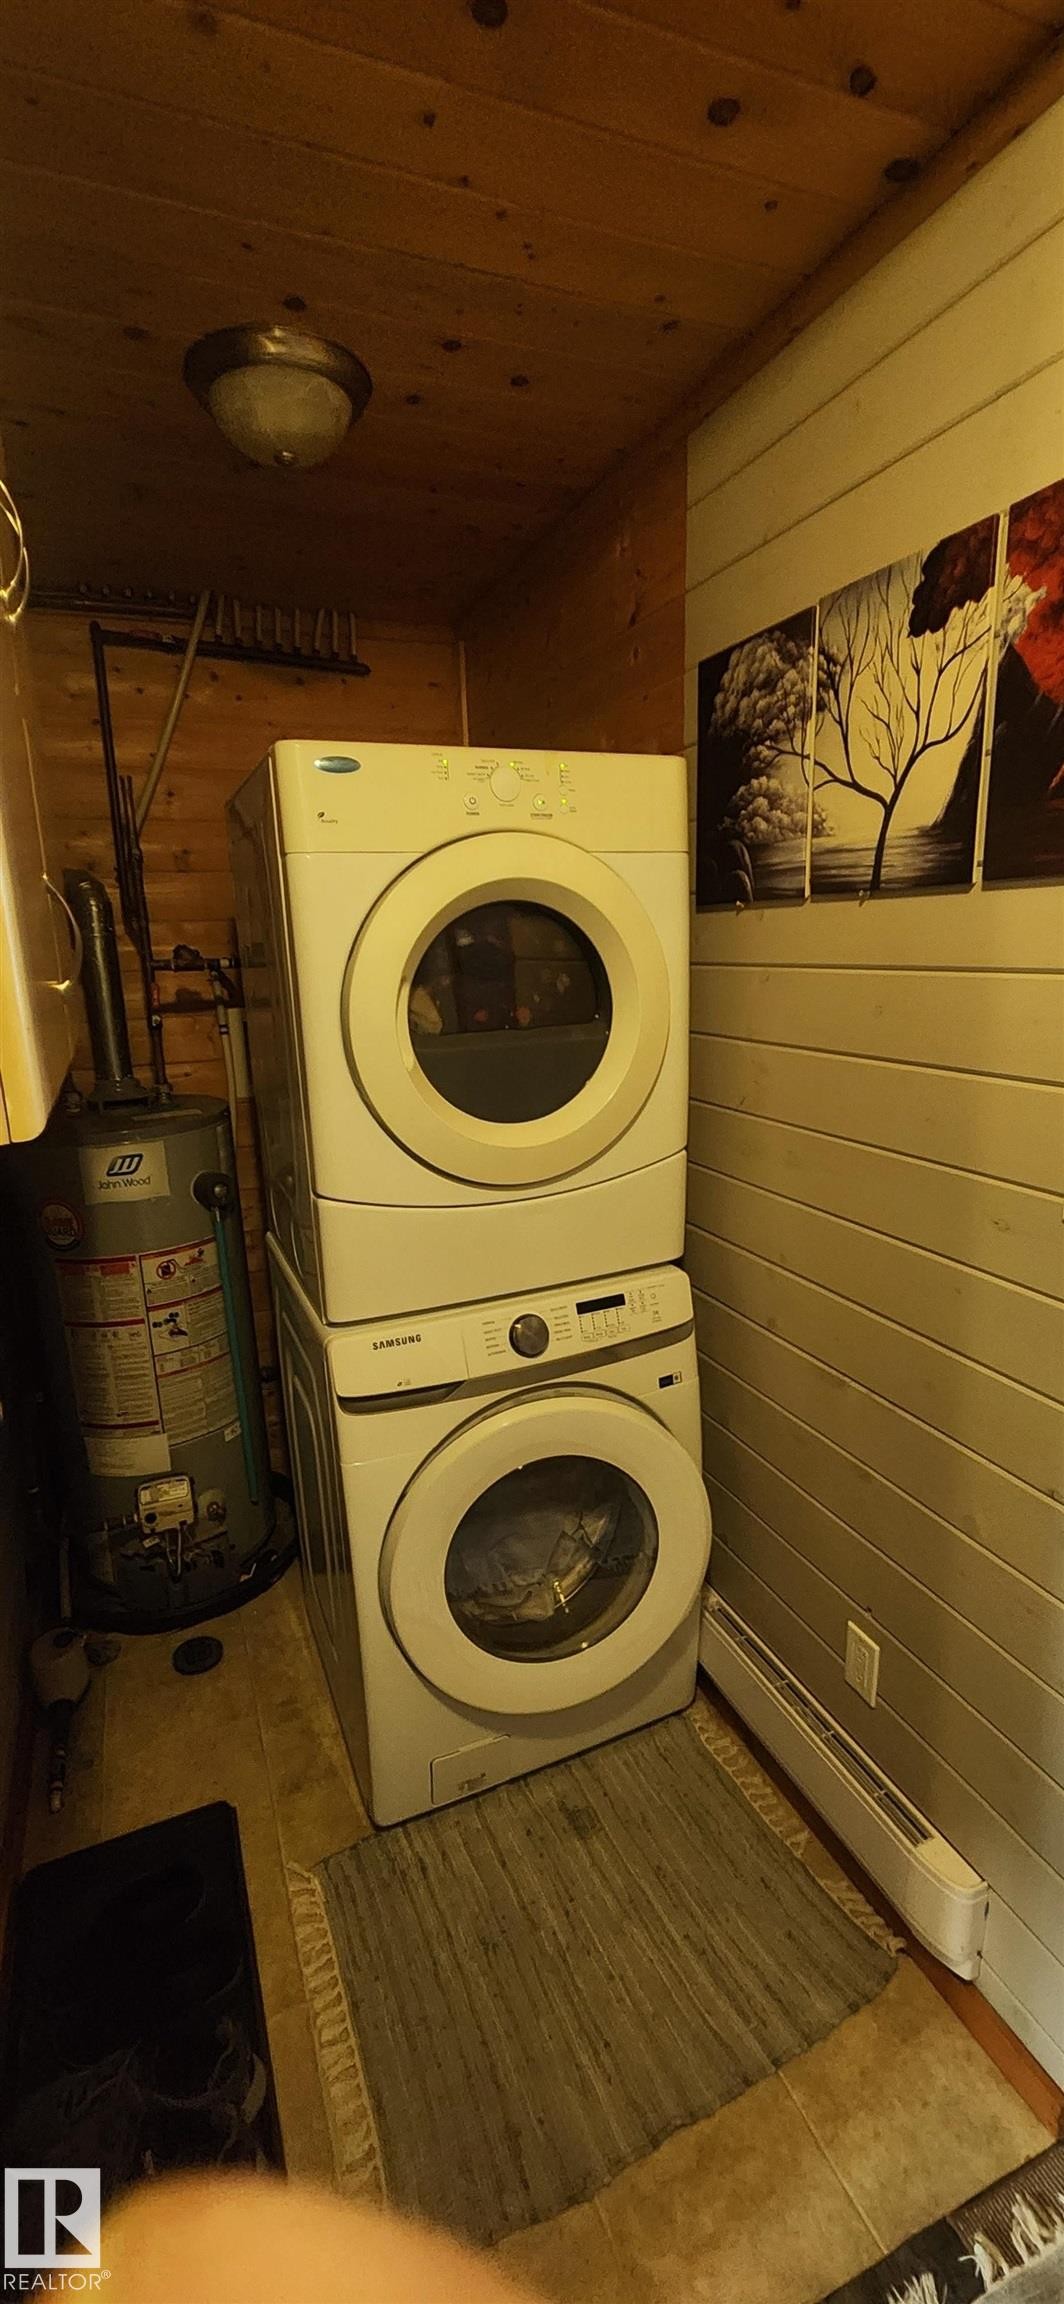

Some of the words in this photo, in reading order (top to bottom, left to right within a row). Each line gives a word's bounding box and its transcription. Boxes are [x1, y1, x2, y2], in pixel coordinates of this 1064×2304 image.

[97, 1179, 121, 1191] John
[122, 1175, 151, 1188] Wood
[372, 1334, 422, 1351] SAMSUNG
